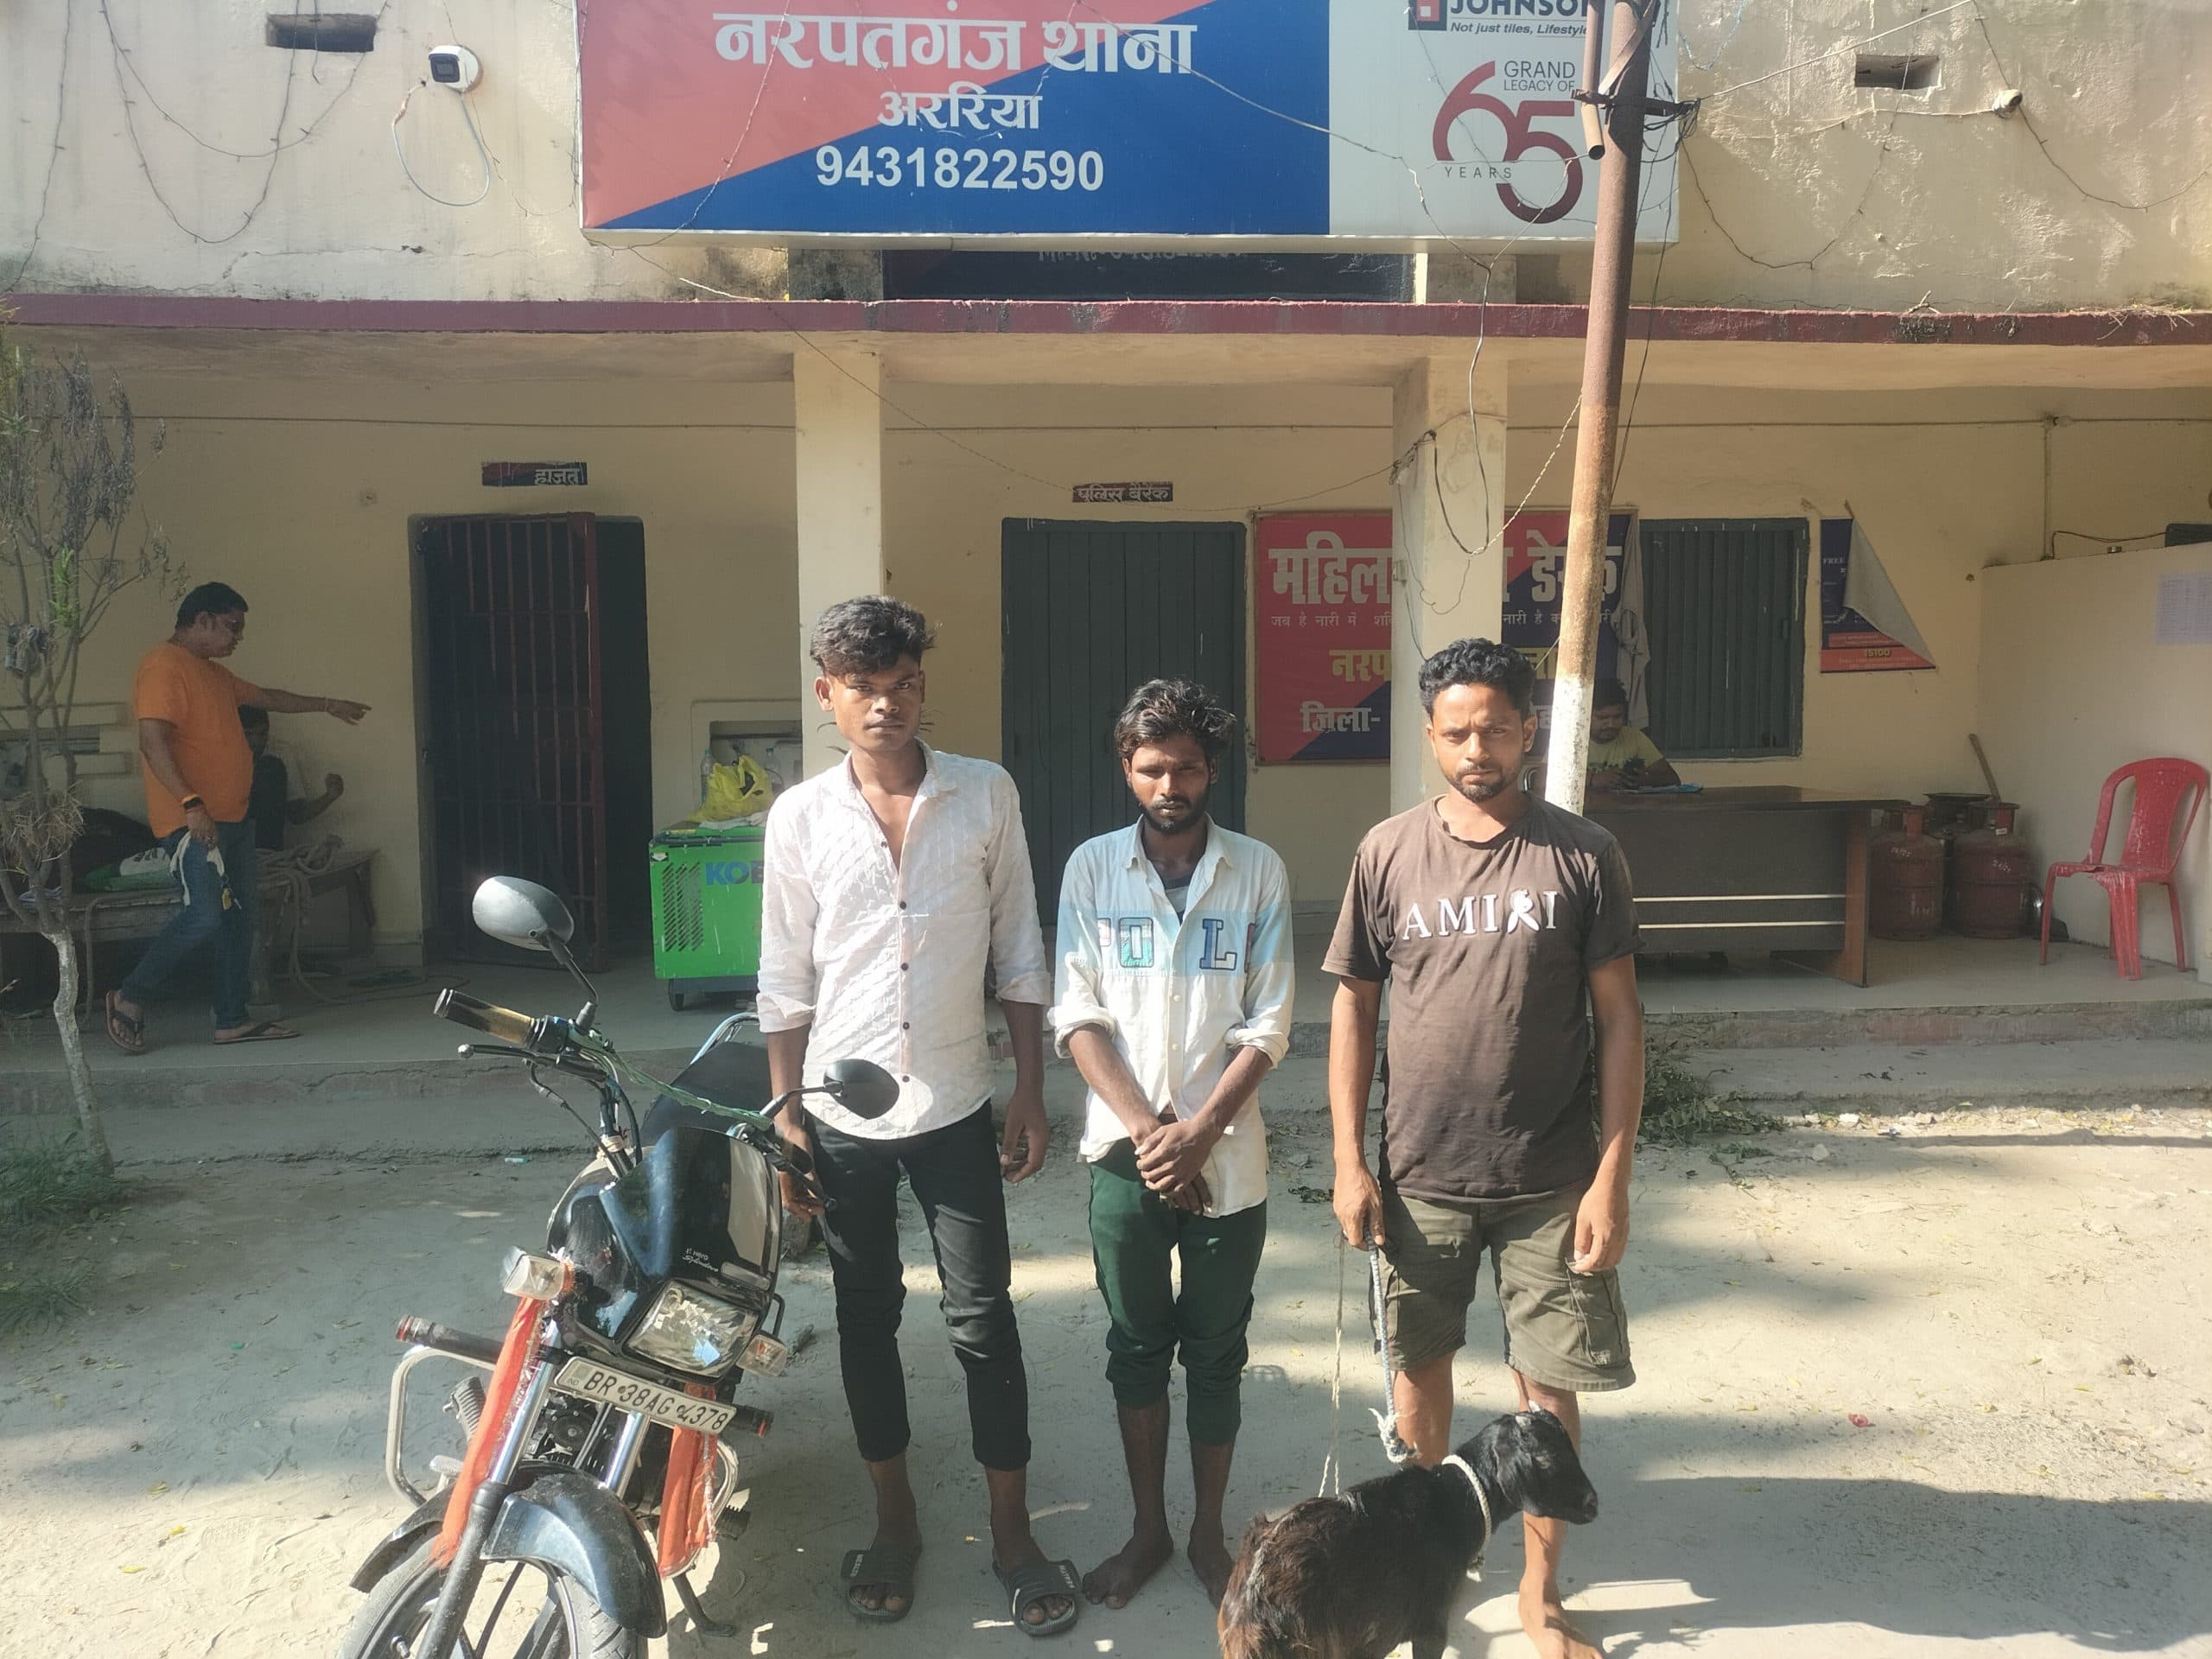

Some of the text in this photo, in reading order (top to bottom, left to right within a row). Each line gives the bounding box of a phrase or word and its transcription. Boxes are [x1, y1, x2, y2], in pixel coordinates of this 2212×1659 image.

[712, 1, 1198, 75] नरपतगंज थाना
[1450, 22, 1473, 33] Not
[1475, 22, 1501, 35] just
[1503, 23, 1534, 35] tiles,
[1503, 60, 1576, 79] GRAND
[1503, 79, 1575, 92] LEGACY OF
[877, 82, 1044, 130] अररिया
[1432, 60, 1584, 225] 65
[816, 145, 1104, 192] 9431822590
[1444, 167, 1512, 180] YEARS
[534, 468, 581, 486] हाजत
[1268, 530, 1393, 605] महिल
[1314, 611, 1341, 627] नारी
[1328, 649, 1392, 683] नरप
[704, 860, 765, 886] KOE
[1402, 887, 1559, 941] AMIRI
[567, 1377, 581, 1388] IND
[583, 1370, 618, 1397] BR
[619, 1383, 676, 1415] 38AG
